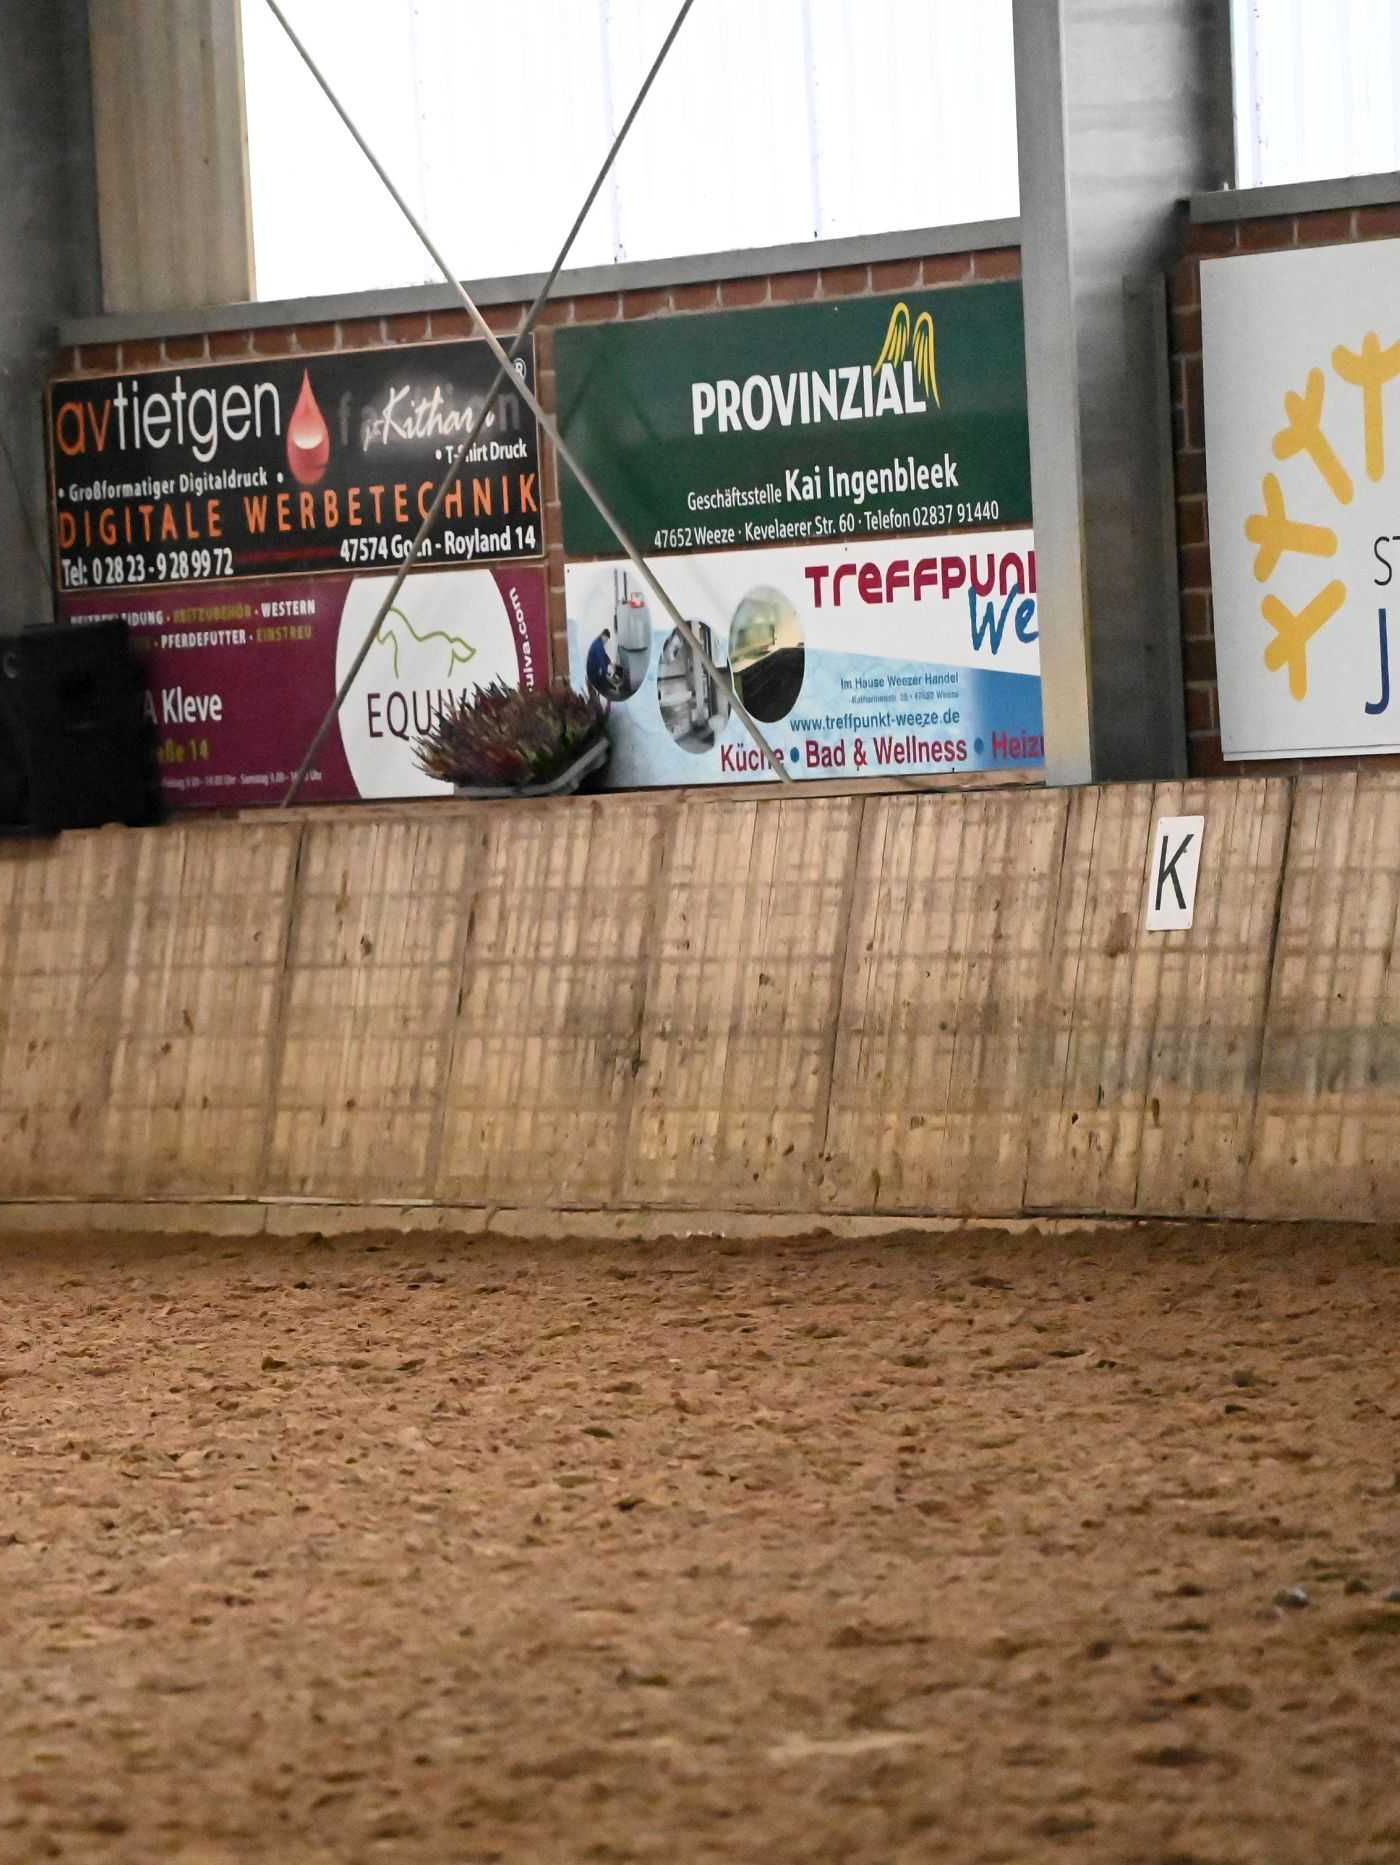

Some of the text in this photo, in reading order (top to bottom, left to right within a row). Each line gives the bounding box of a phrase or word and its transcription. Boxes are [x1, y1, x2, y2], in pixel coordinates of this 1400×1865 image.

[692, 360, 927, 436] PROVINZIAL
[56, 375, 281, 463] avtietgen
[489, 438, 528, 461] Druck
[68, 466, 269, 502] Großformatiger Digitaldruck
[687, 453, 959, 511] Geschäftsstelle Kai Ingenbleek
[57, 472, 538, 549] DIGITALE WERBETECHNIK
[654, 500, 999, 549] 47652 Weeze Kevelaerer Str. 60 Telefon 02837 91440
[339, 536, 388, 563] 47574
[444, 526, 512, 560] Royland
[515, 525, 536, 550] 14
[261, 599, 316, 618] WESTERN
[160, 629, 247, 650] PFERDEFUTTER
[840, 672, 959, 689] Im Hause Weezer Handel
[162, 685, 223, 725] Kleve
[790, 707, 960, 732] www.treffpunkt-weeze.de
[805, 738, 846, 768] Bad
[853, 738, 867, 768] &
[873, 735, 967, 765] Wellness
[1154, 833, 1195, 912] K
